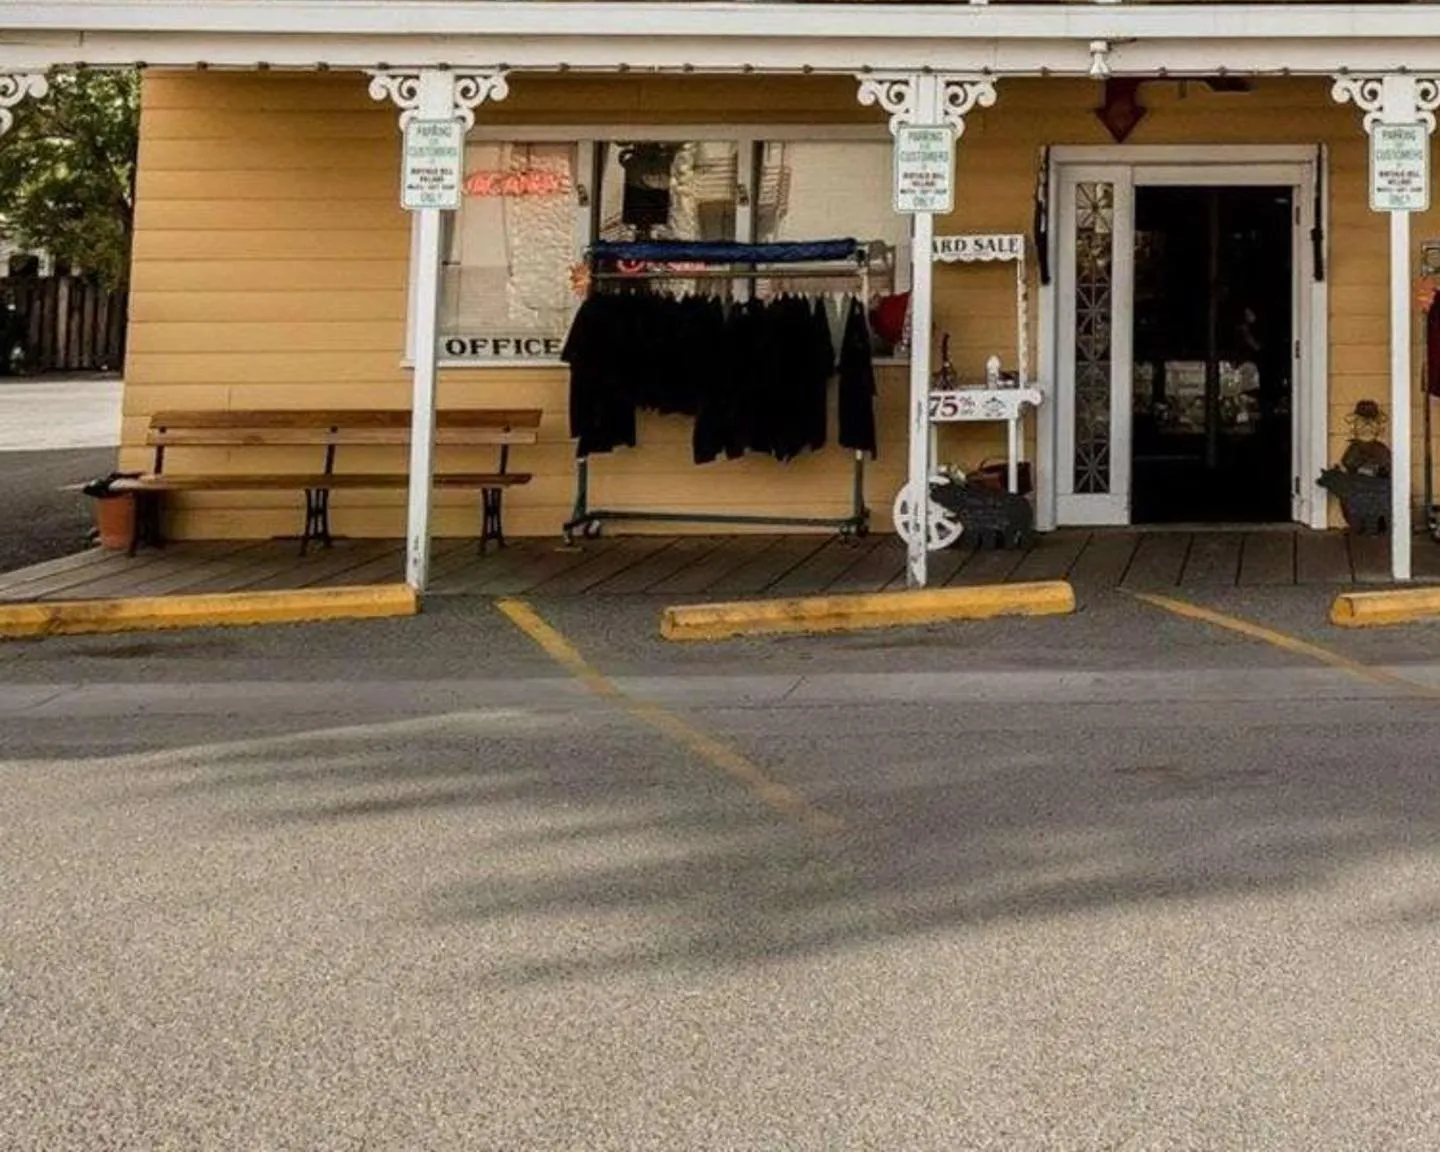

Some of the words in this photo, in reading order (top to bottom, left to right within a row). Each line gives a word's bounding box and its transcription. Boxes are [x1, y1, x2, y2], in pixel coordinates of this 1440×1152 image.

[907, 131, 943, 142] PARKING
[1382, 129, 1417, 140] PARKING
[973, 237, 1019, 253] SALE
[446, 338, 563, 356] OFFICE
